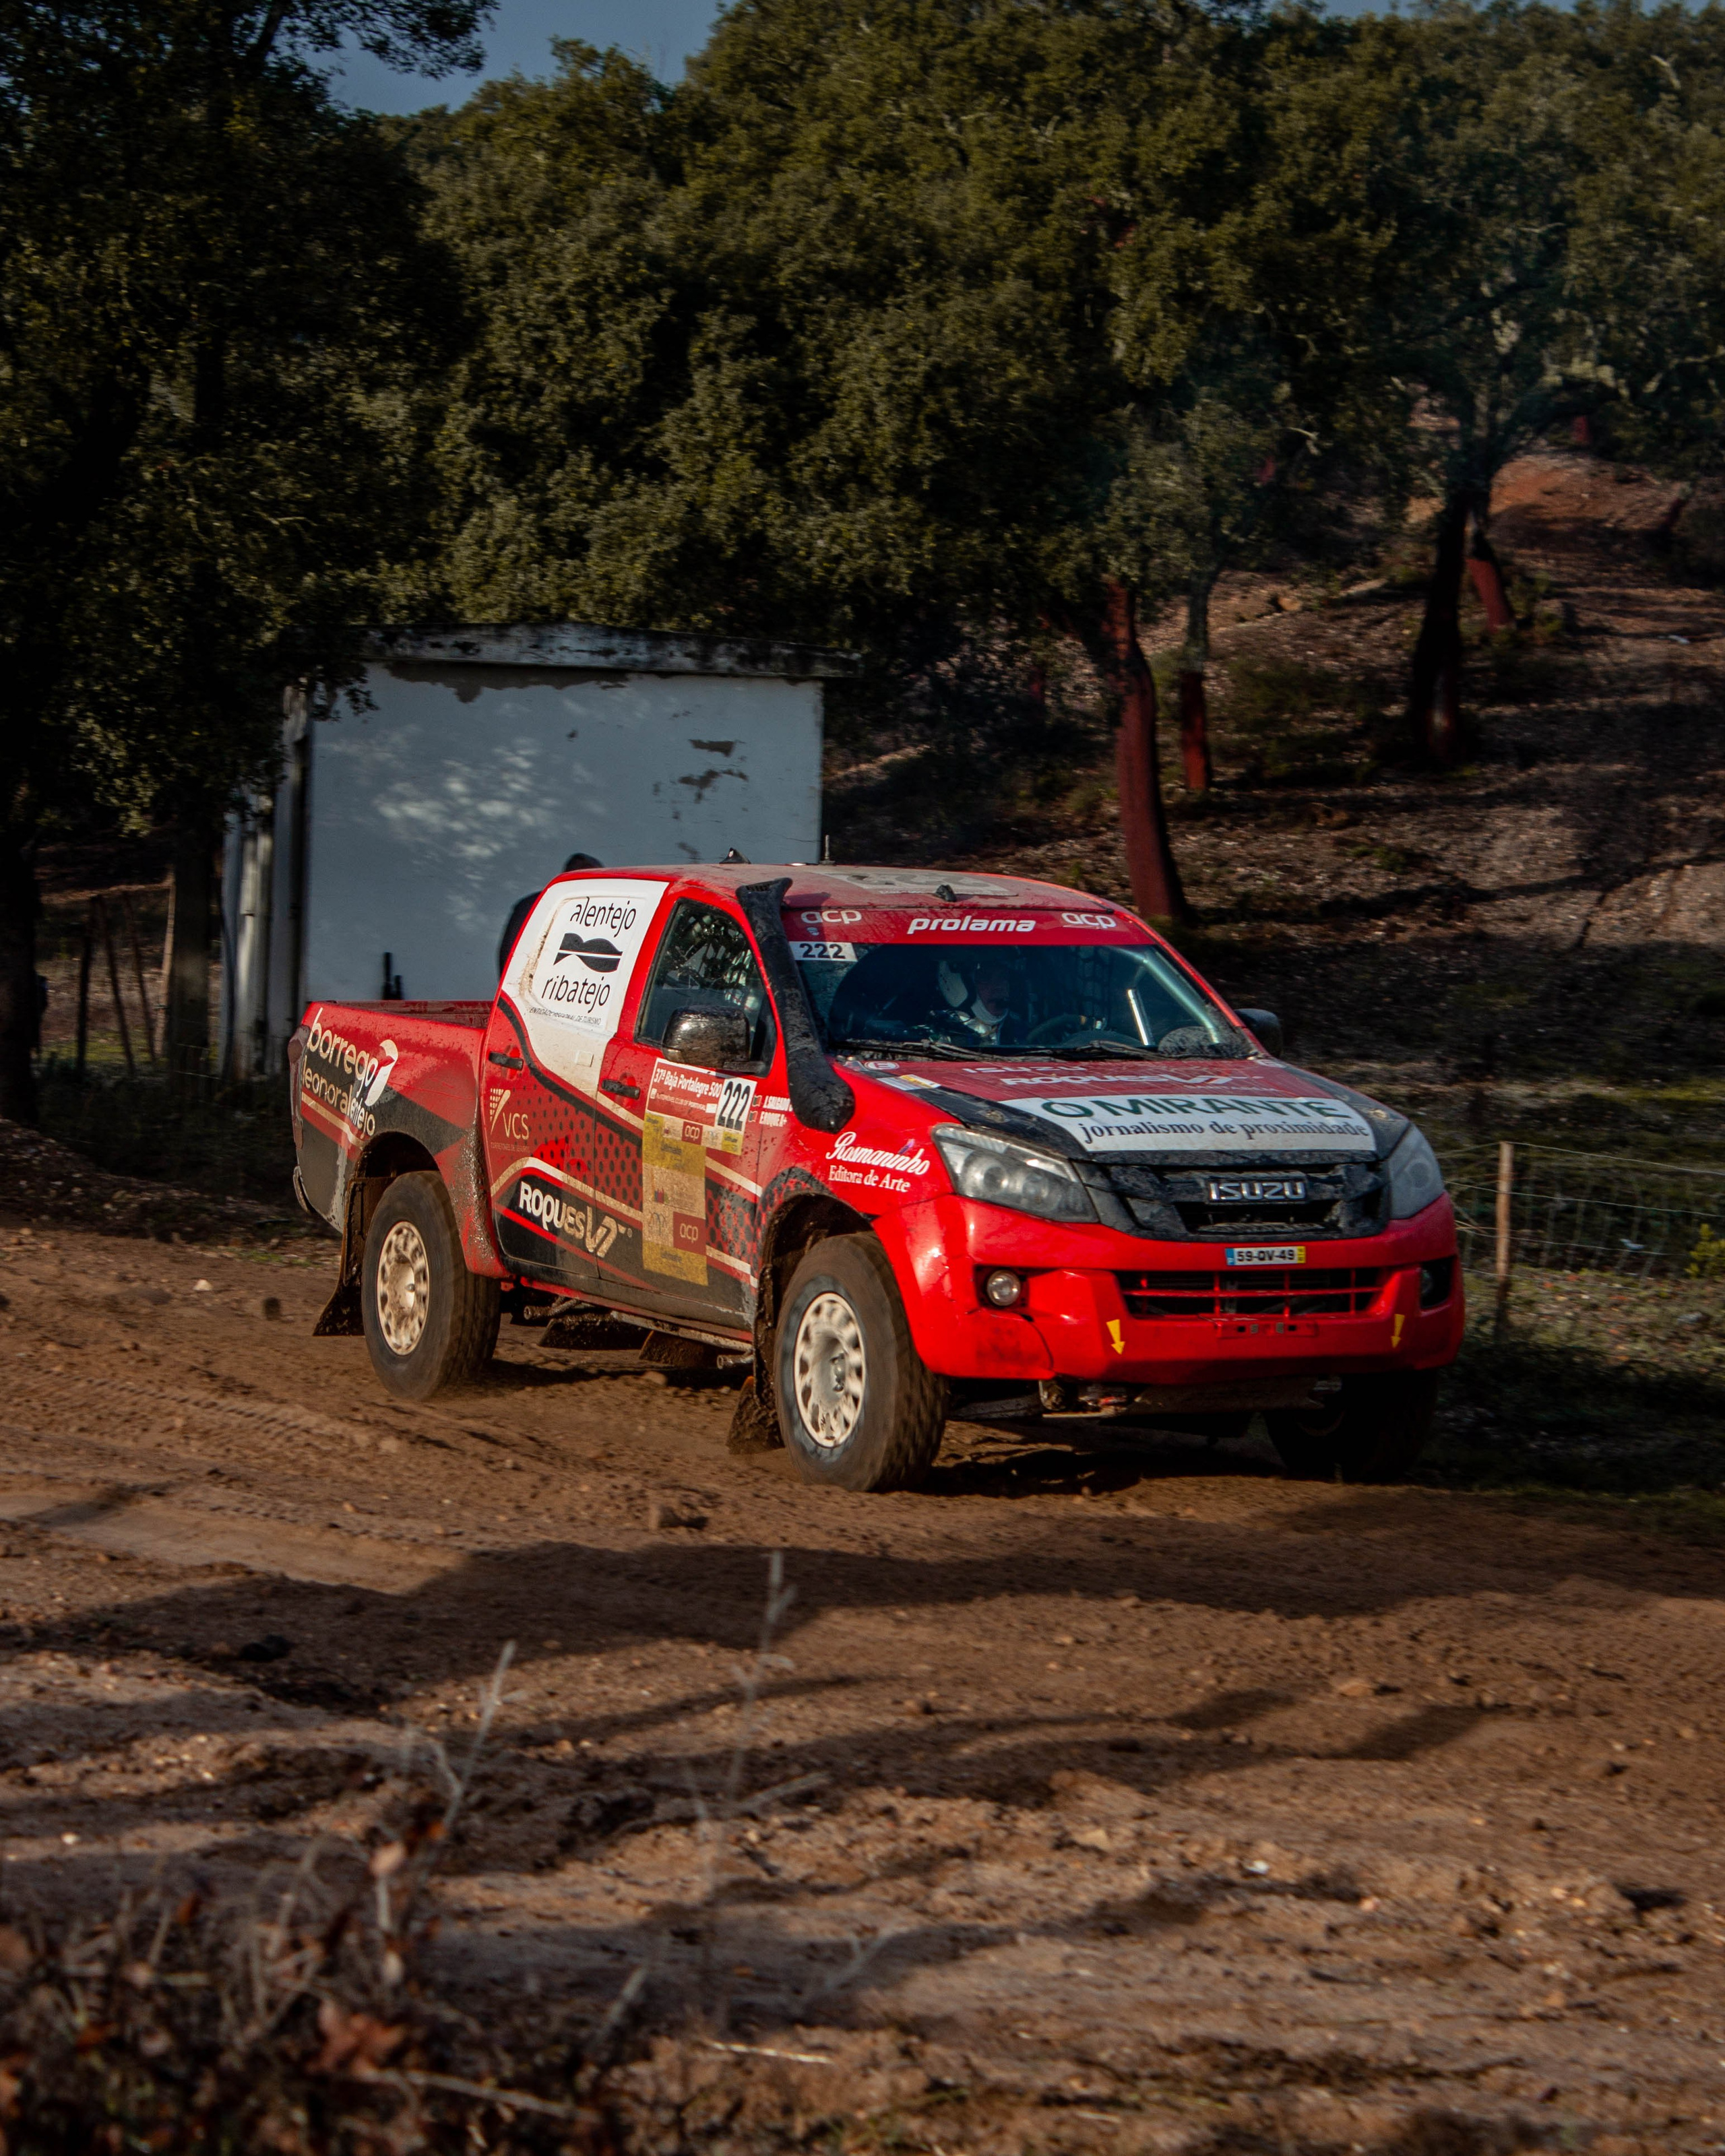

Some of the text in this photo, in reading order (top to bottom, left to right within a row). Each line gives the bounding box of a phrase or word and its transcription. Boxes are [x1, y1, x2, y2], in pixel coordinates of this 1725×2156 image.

[569, 896, 637, 938] alentejo
[907, 915, 1037, 934] prolama
[798, 943, 846, 959] 222
[541, 974, 611, 1013] ribatejo
[307, 1007, 379, 1098] borrego
[664, 1071, 679, 1091] Baja
[677, 1074, 710, 1098] Portalegre
[708, 1081, 723, 1098] 500
[718, 1080, 751, 1132] 222
[1041, 1097, 1352, 1119] O MIRANTE
[503, 1112, 530, 1140] VCS
[1078, 1120, 1369, 1144] jornalismo de proximidade
[828, 1164, 911, 1193] Editora de Arte
[1210, 1181, 1306, 1201] ISUZU
[1236, 1248, 1295, 1263] 59-QV-49
